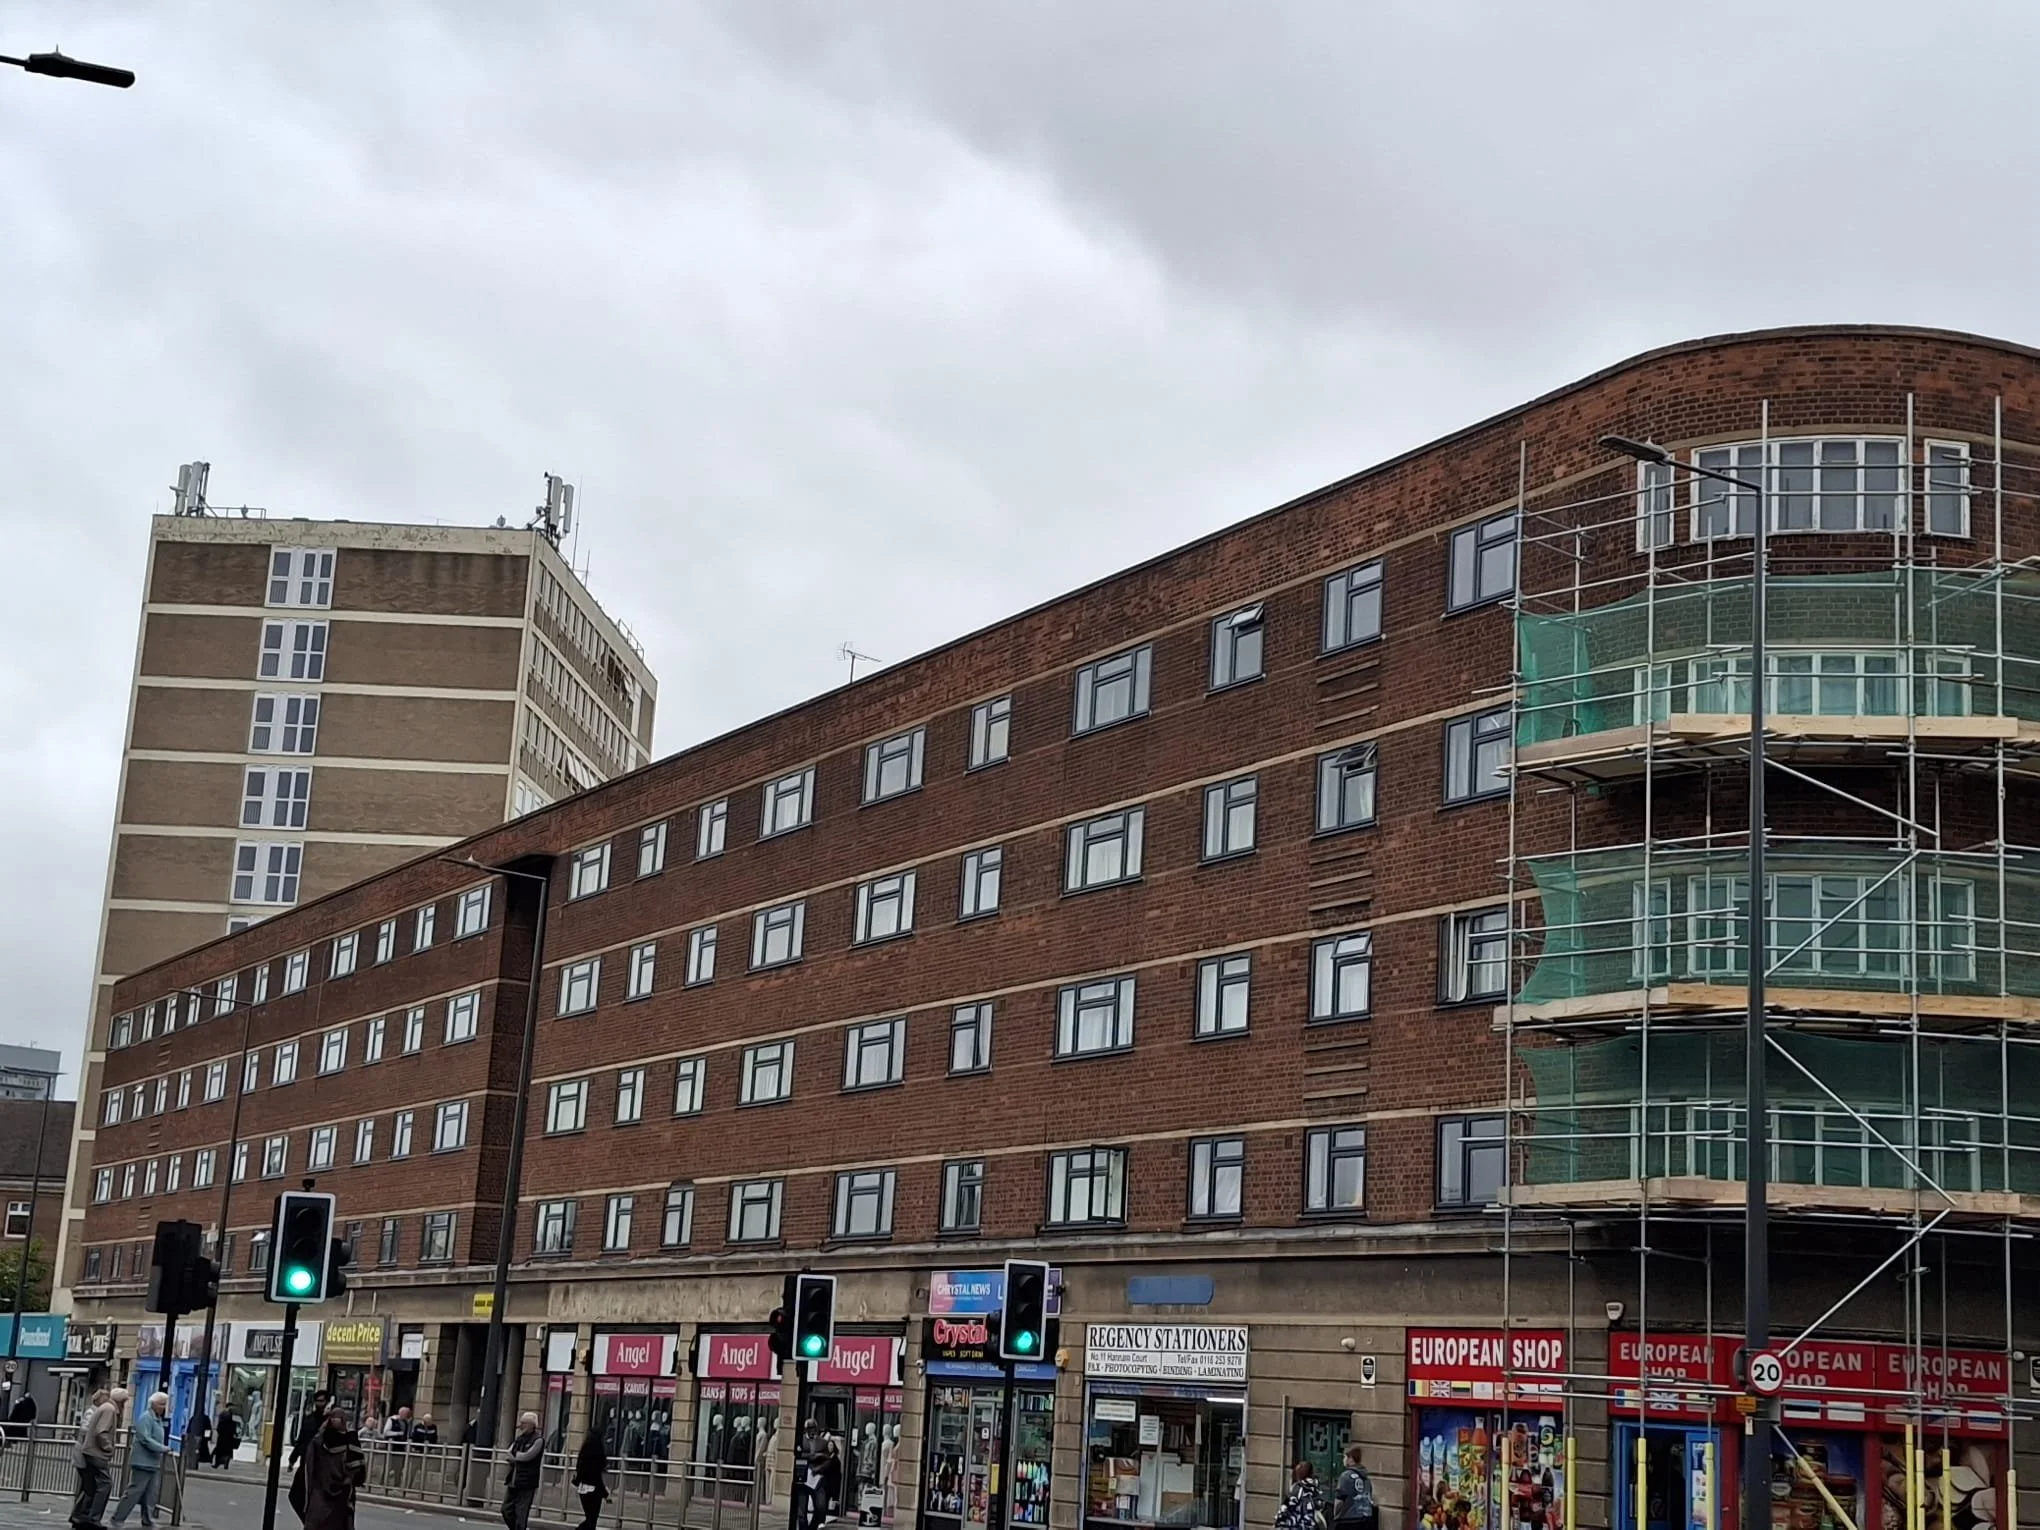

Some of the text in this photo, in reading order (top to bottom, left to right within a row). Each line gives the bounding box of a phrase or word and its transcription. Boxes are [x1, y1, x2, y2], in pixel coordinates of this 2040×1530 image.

[971, 1283, 992, 1296] NEWS
[327, 1322, 380, 1342] decent Price
[1089, 1327, 1246, 1351] REGENCY STATIONERS
[616, 1341, 650, 1369] Angel
[719, 1342, 758, 1372] Angel
[831, 1345, 876, 1376] Angel
[1411, 1337, 1562, 1368] EUROPEAN SHOP
[1088, 1362, 1100, 1371] FAX
[1105, 1363, 1158, 1374] PHOTOCOPYING
[1753, 1364, 1780, 1382] 20
[731, 1388, 748, 1400] TOPS
